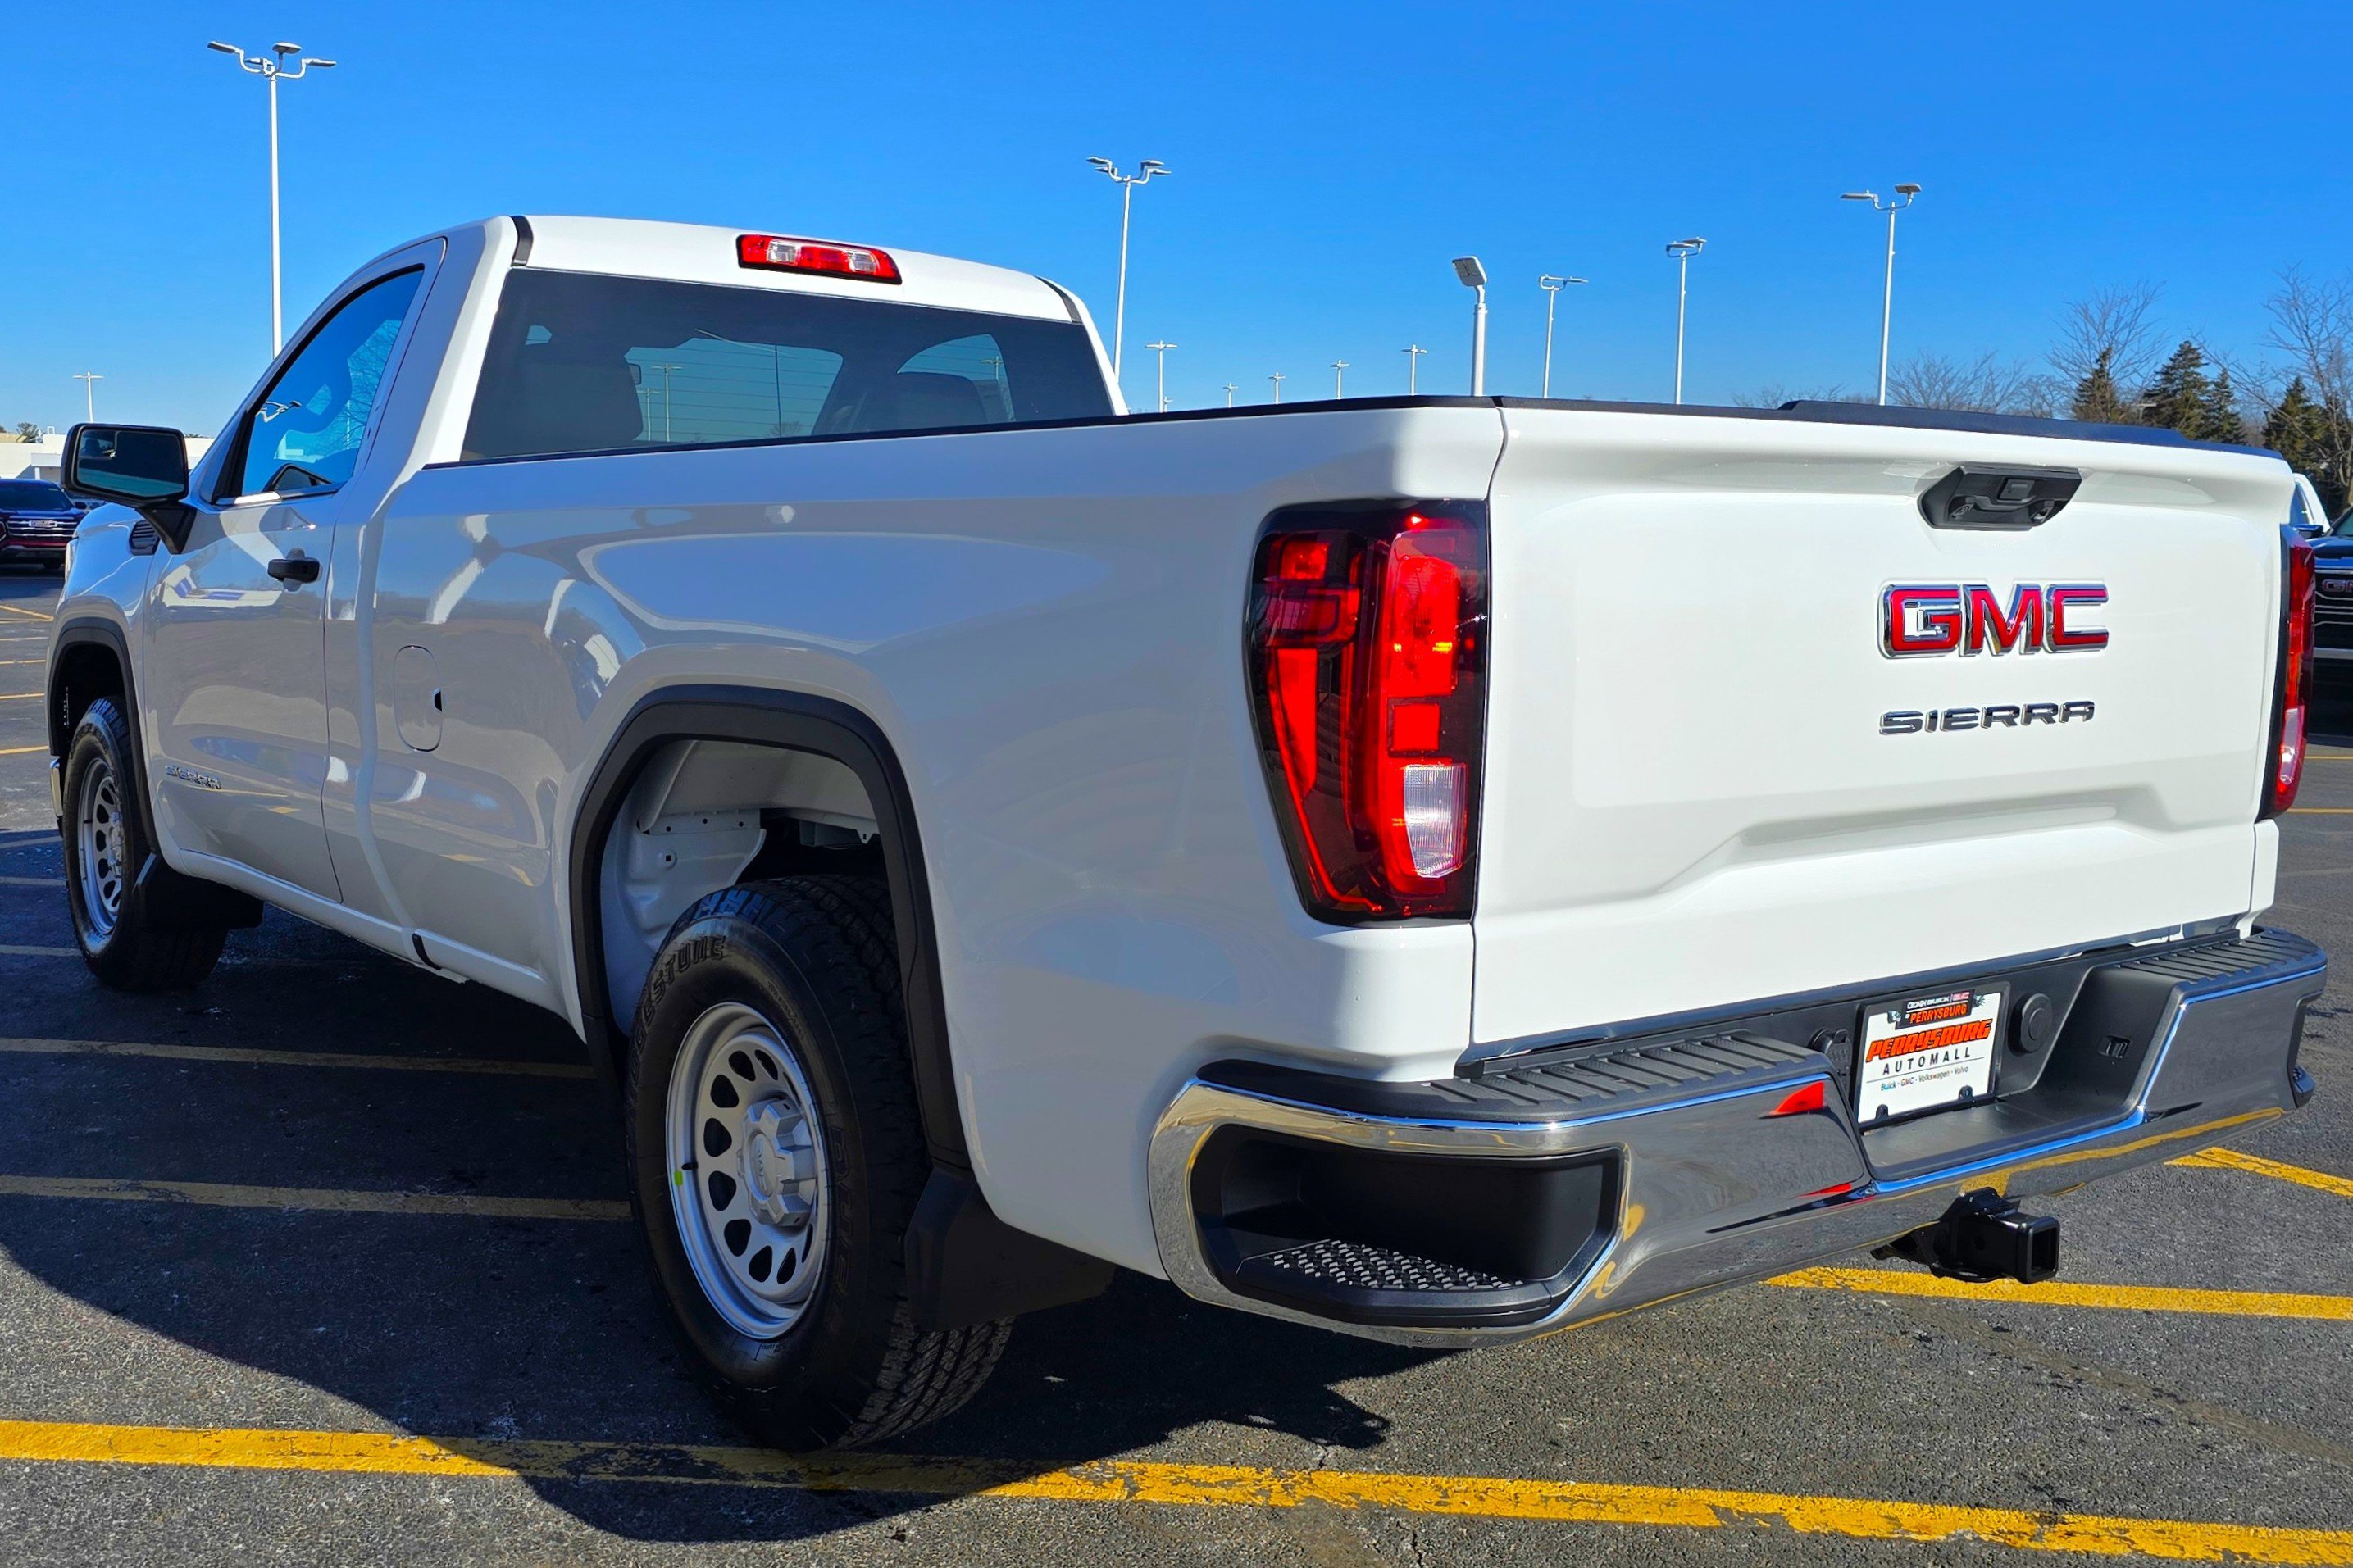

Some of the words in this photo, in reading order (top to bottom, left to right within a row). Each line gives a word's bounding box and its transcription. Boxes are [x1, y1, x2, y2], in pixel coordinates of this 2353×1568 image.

[1877, 582, 2110, 659] GMC
[1878, 700, 2096, 735] SIERRA
[165, 764, 221, 790] SIERRA
[1909, 1003, 1968, 1024] PERRYSBURG
[1865, 1019, 1994, 1063] PERRYSBURG
[1882, 1047, 1971, 1075] AUTOMALL
[1881, 1080, 1896, 1091] Buick
[1900, 1077, 1914, 1087] GMC
[1918, 1070, 1950, 1083] Volkswagen
[1954, 1066, 1969, 1075] Volvo
